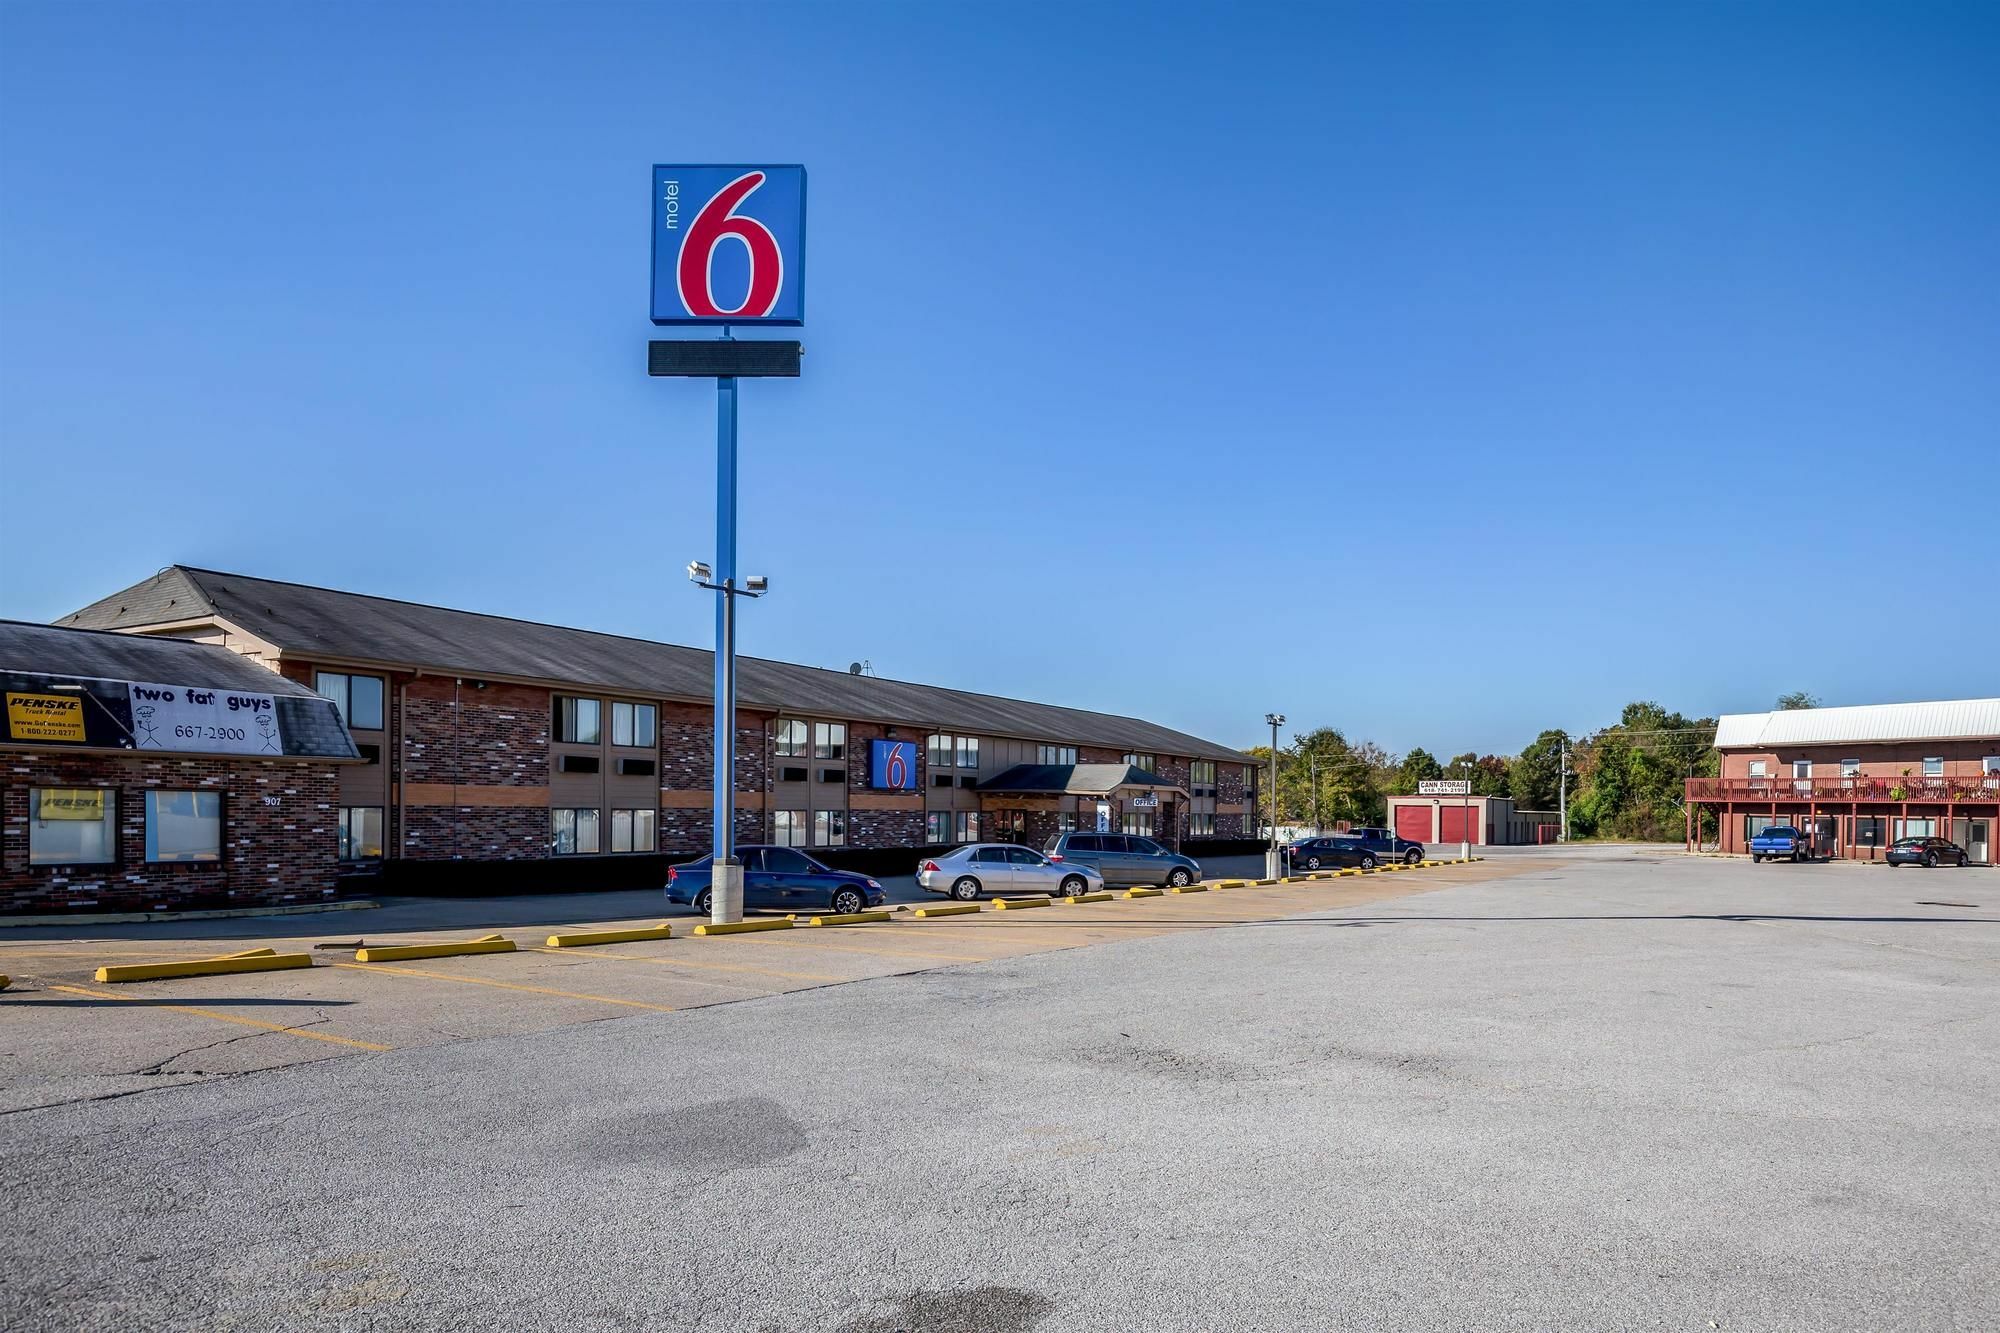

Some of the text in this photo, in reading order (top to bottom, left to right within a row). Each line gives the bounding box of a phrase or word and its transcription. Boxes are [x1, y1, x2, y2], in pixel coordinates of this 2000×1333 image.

[664, 180, 679, 229] motel
[676, 170, 784, 317] 6
[9, 697, 79, 710] PENSKE
[132, 685, 271, 712] two fat guys
[175, 725, 245, 741] 667-2900
[886, 742, 907, 789] 6
[44, 798, 101, 807] PENSKE
[265, 797, 281, 806] 907
